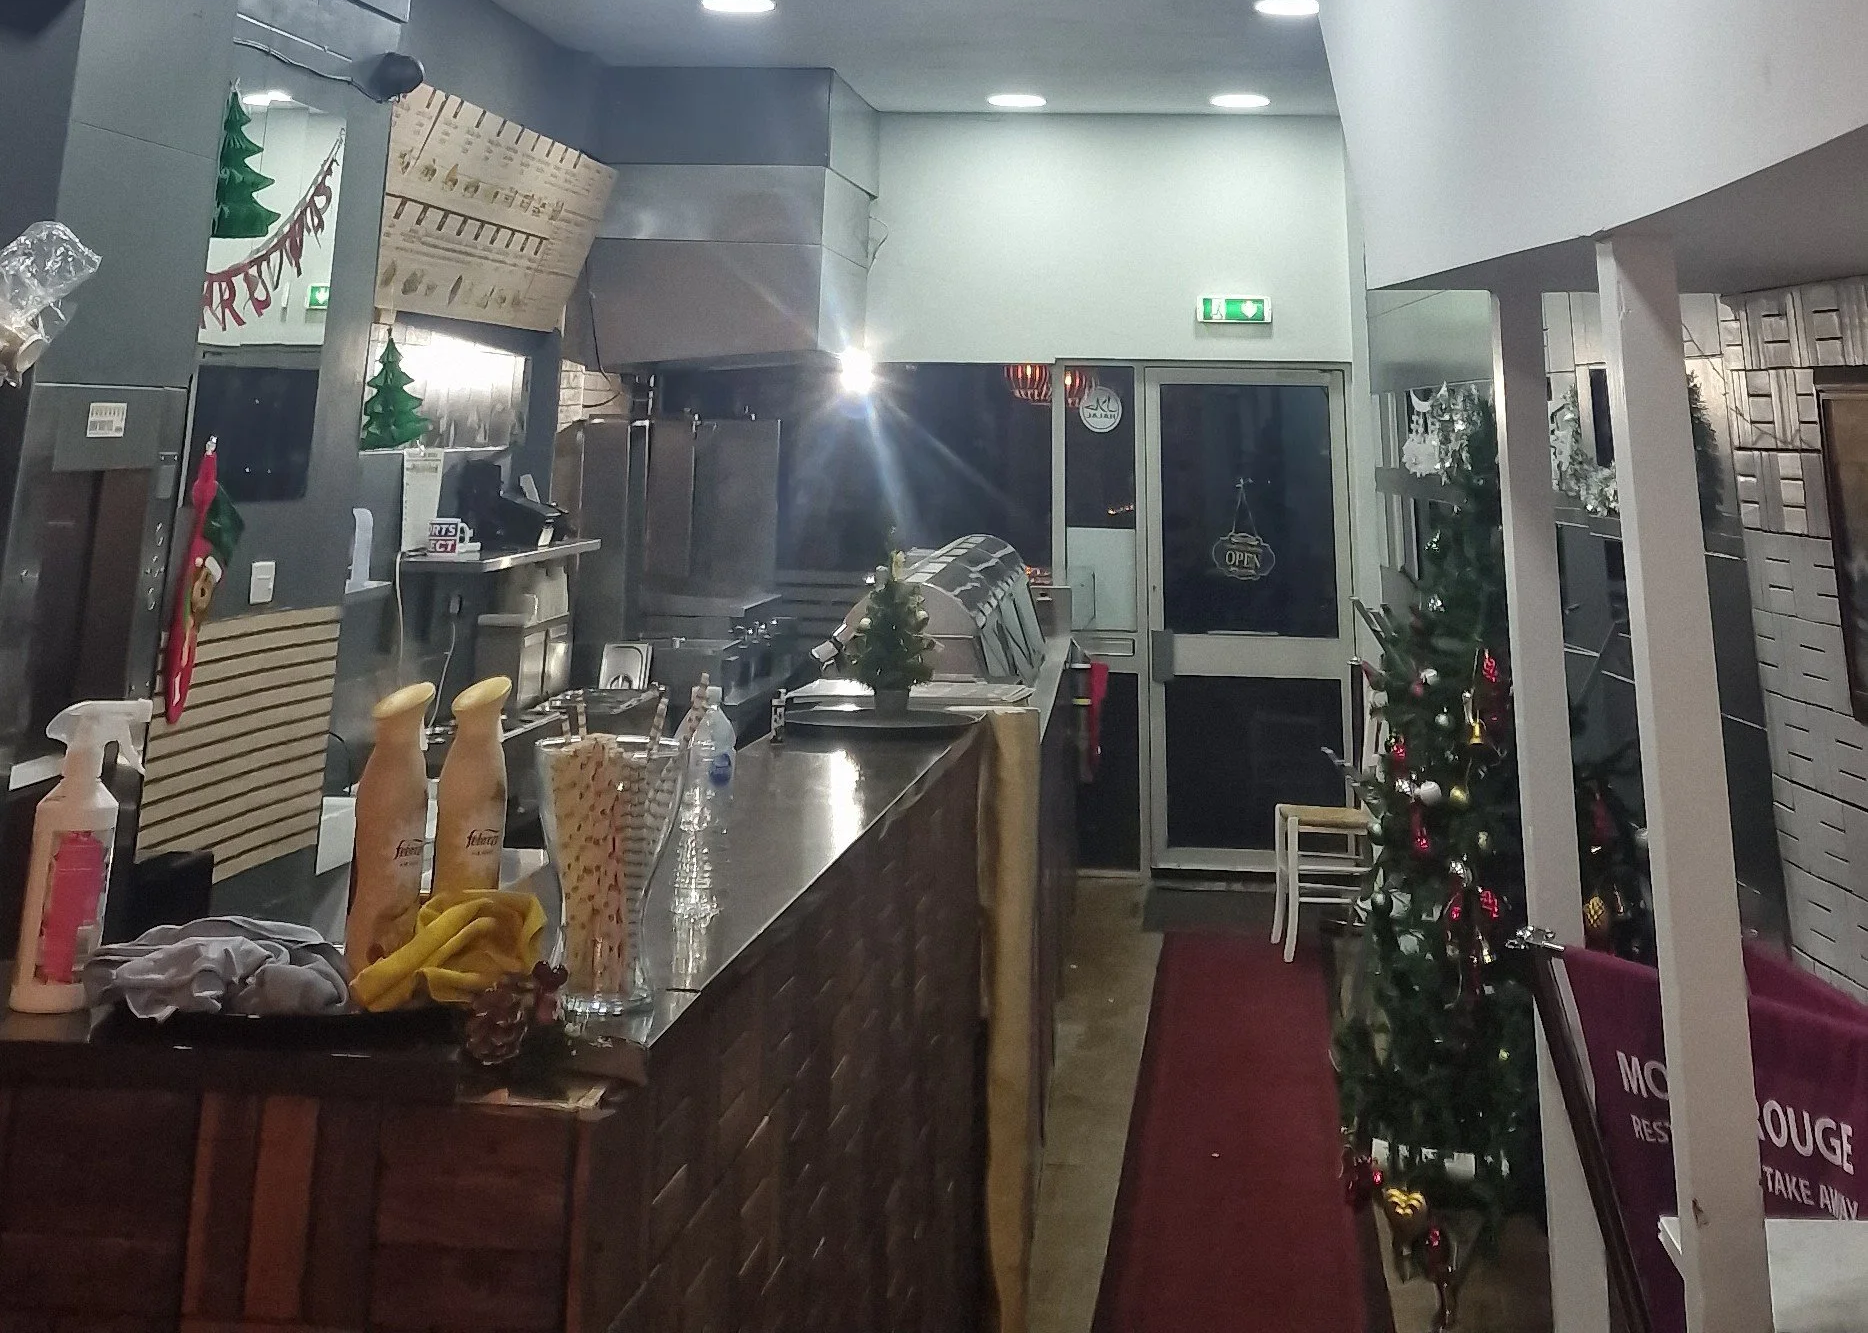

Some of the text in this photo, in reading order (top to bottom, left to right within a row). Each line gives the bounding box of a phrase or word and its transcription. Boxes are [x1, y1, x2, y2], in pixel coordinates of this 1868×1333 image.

[1616, 1049, 1670, 1101] MO
[1630, 1113, 1859, 1221] RES TAKE AWAY
